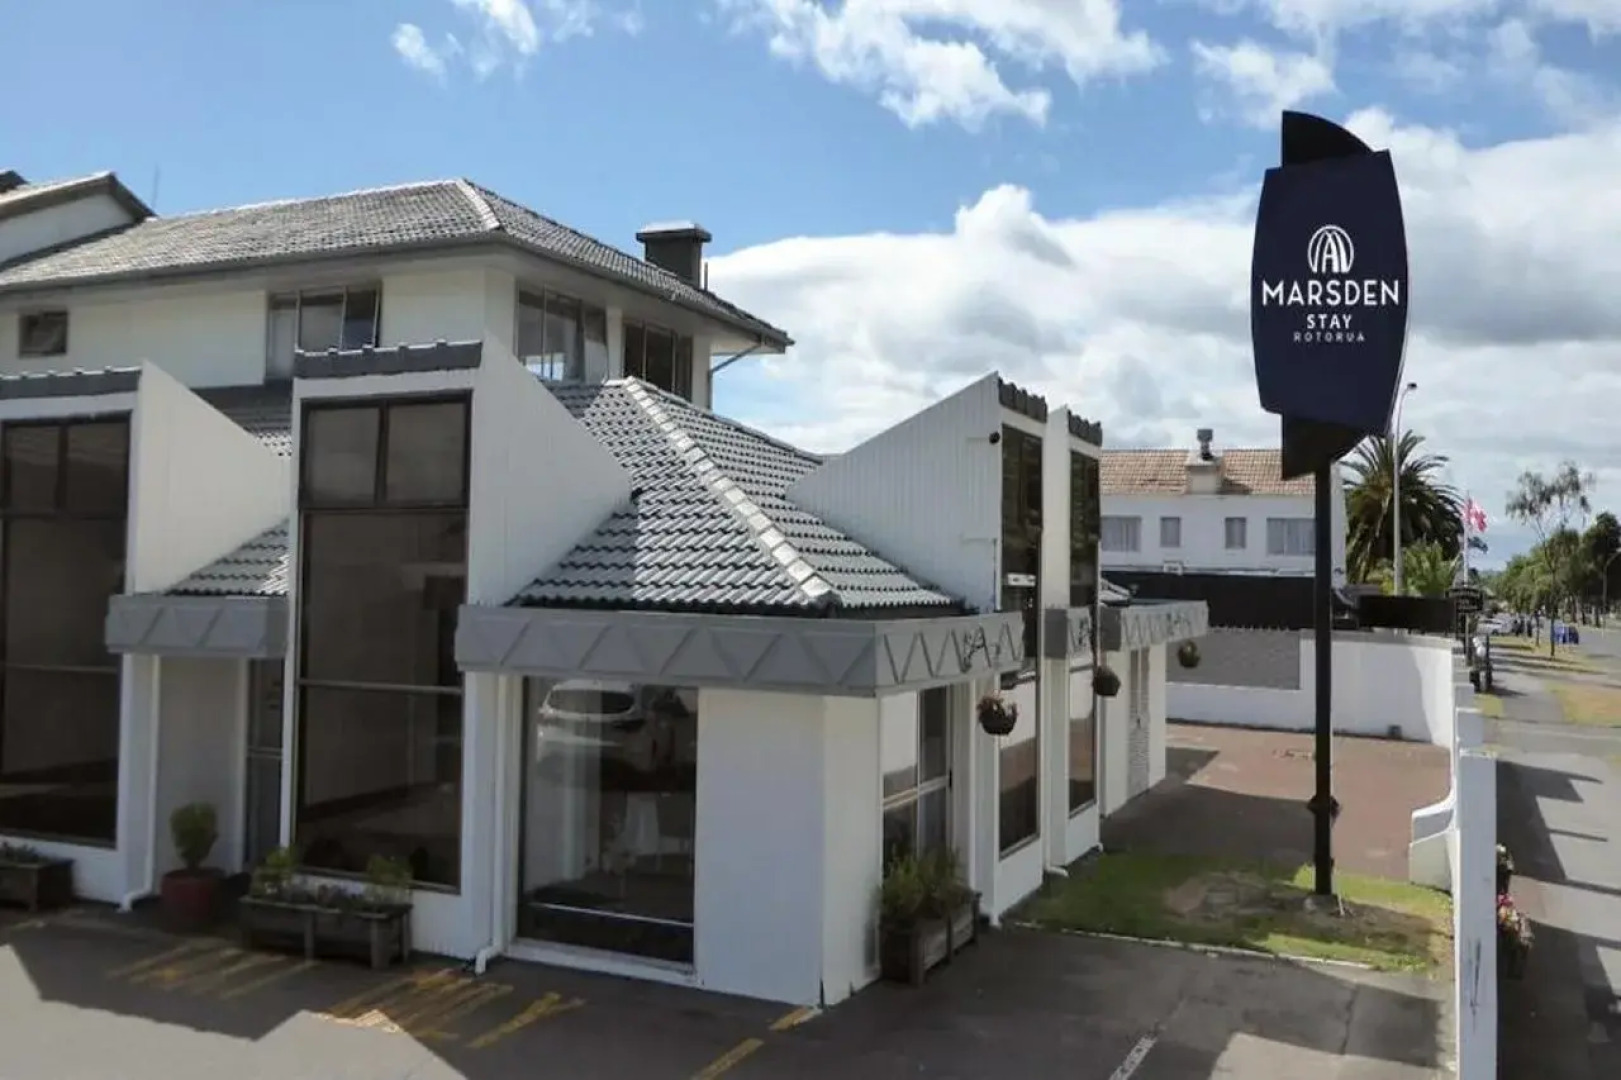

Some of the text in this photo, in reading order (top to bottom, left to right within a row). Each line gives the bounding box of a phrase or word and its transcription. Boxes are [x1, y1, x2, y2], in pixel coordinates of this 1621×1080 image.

[1262, 280, 1399, 306] MARSDEN
[1306, 313, 1352, 329] STAY
[1293, 331, 1365, 342] ROTORUA
